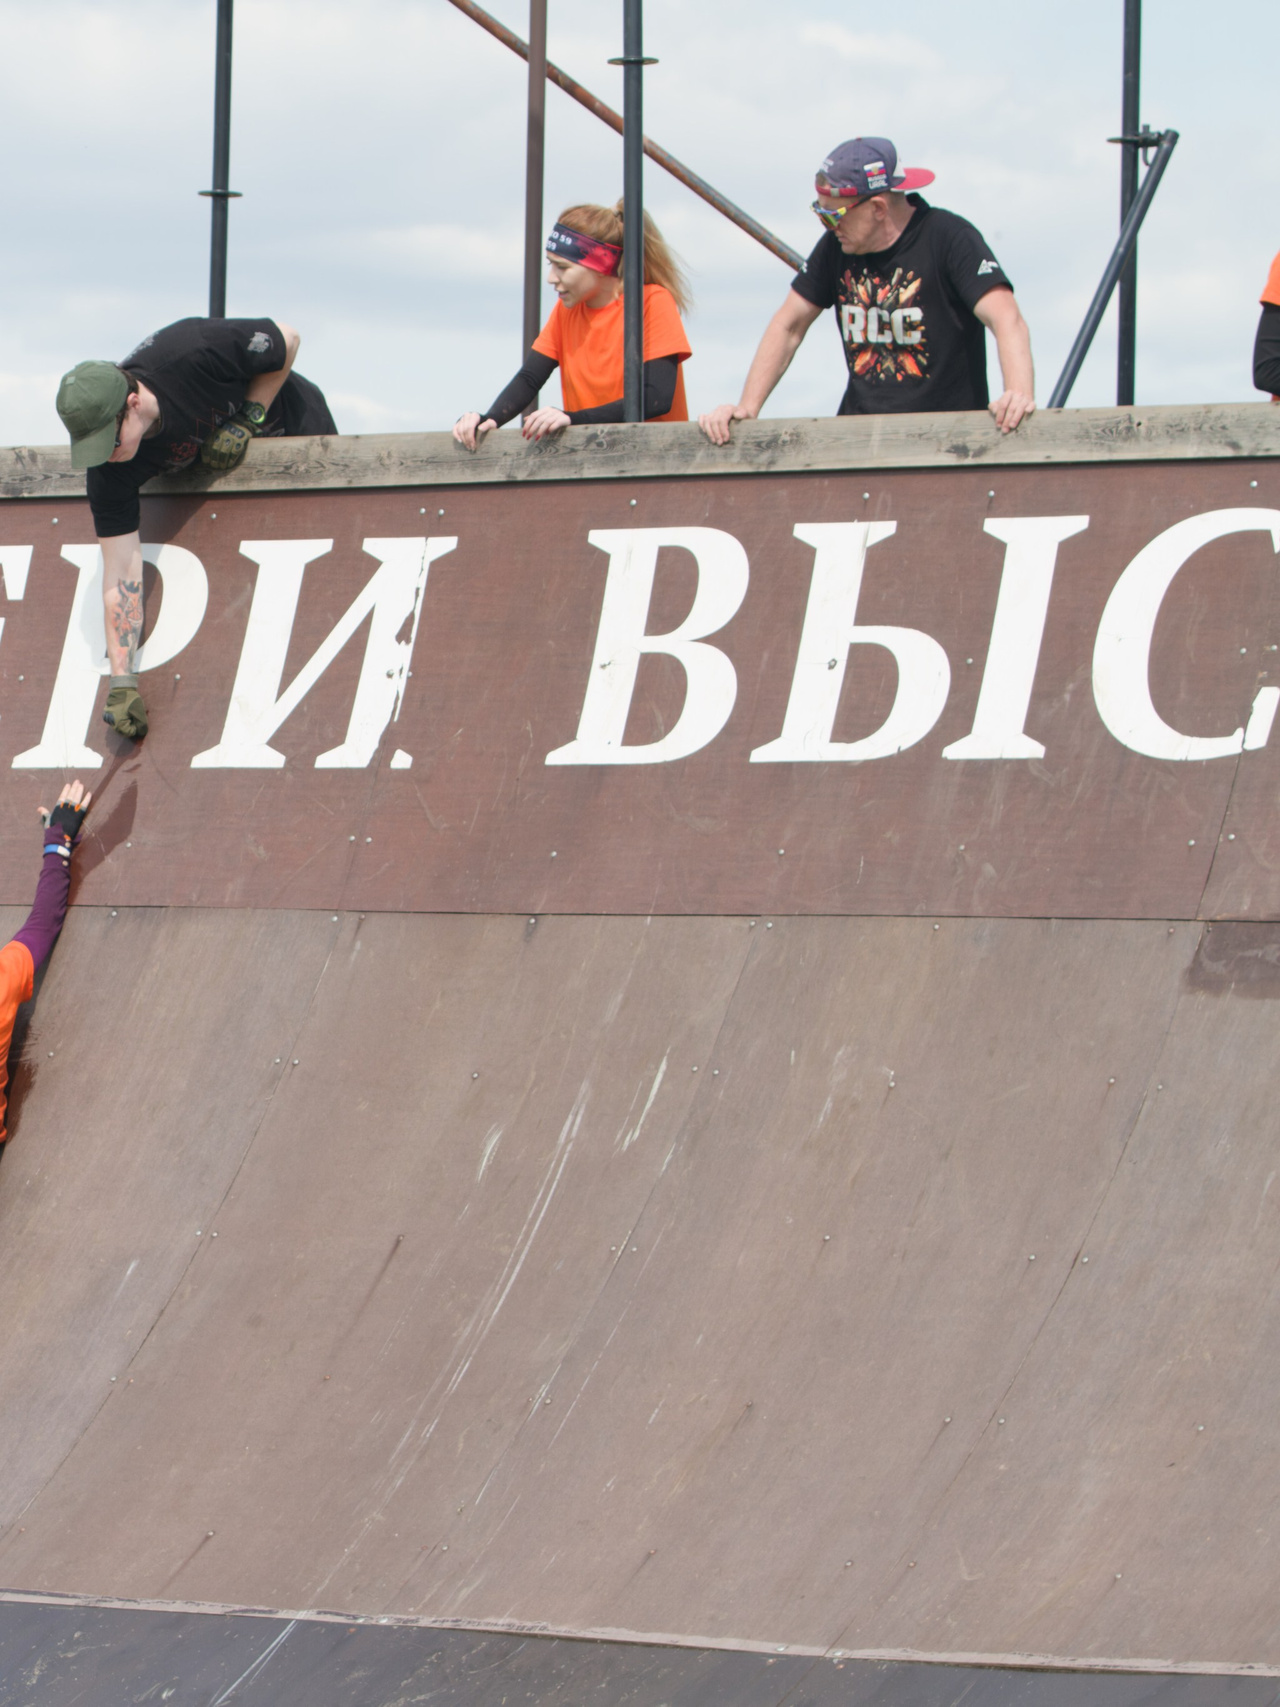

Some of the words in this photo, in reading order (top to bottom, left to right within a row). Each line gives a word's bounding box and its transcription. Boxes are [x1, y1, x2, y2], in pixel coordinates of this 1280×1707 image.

[559, 234, 573, 246] 59
[841, 304, 924, 345] RCC
[544, 507, 1280, 766] ВЫС
